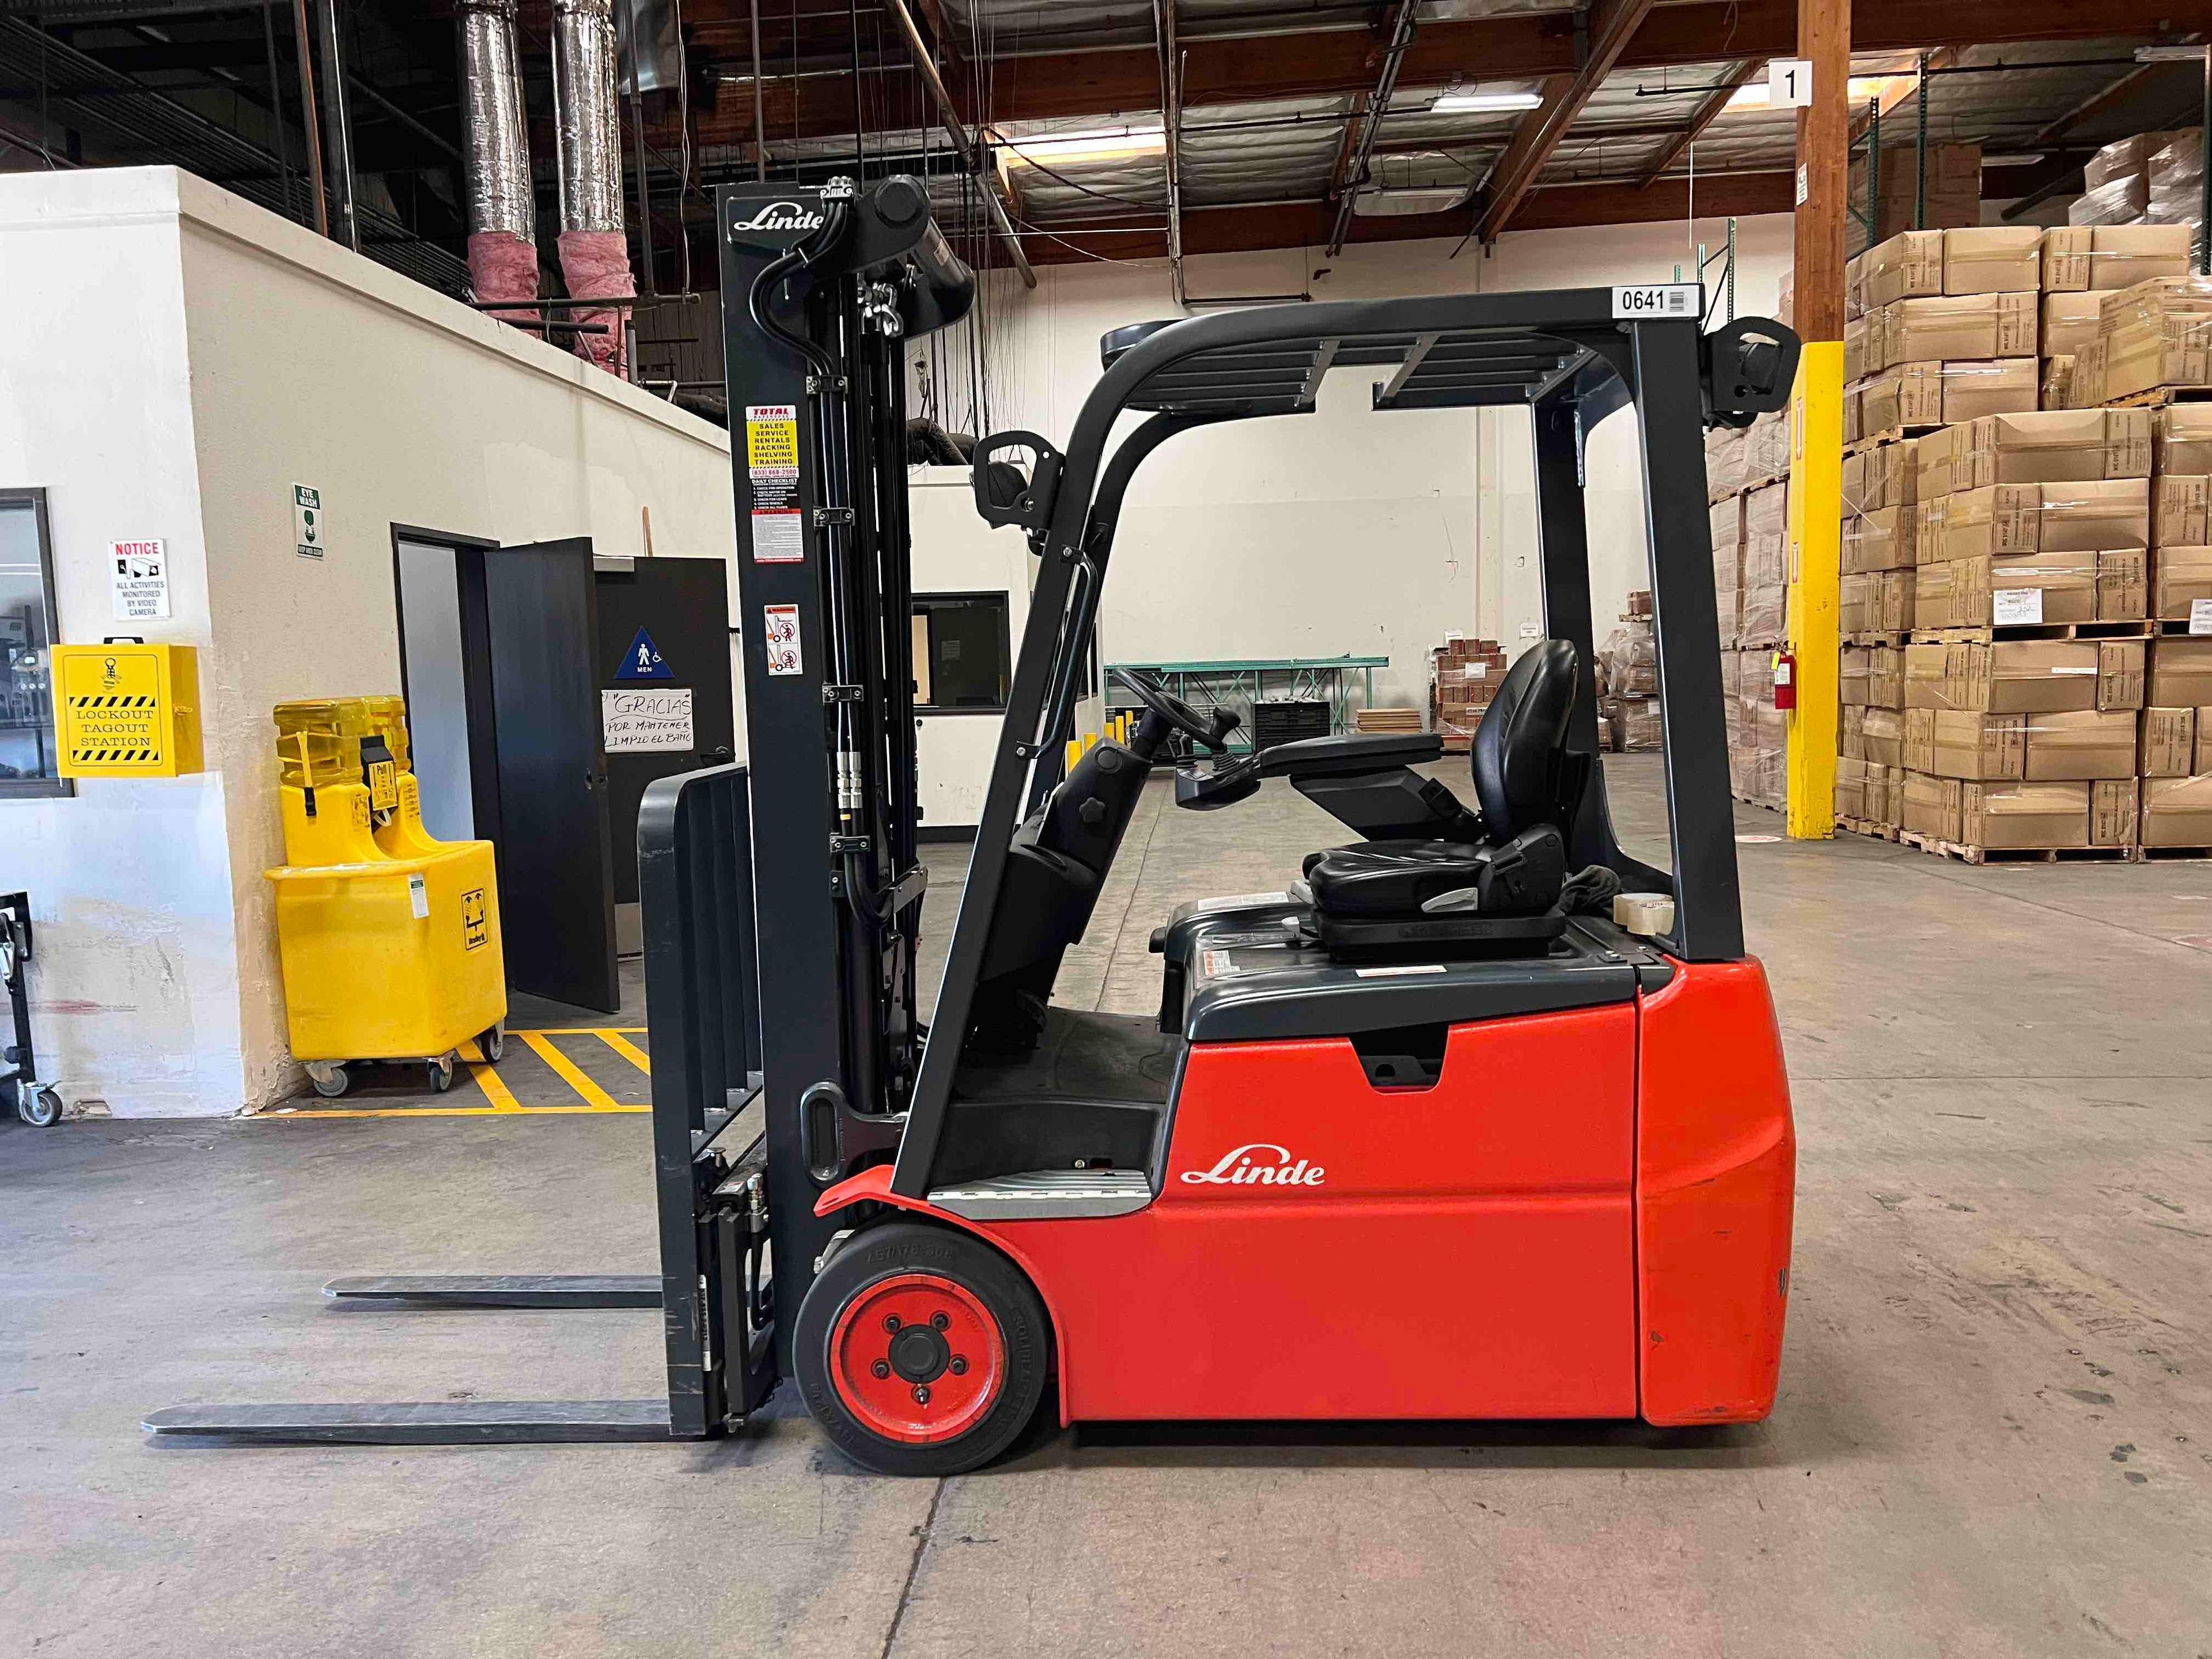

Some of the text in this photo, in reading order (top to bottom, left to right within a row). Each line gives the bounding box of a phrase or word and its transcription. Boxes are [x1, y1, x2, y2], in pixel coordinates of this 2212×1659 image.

[1785, 70, 1795, 99] 1
[733, 202, 824, 230] Linde
[1623, 290, 1663, 310] 0641
[301, 488, 313, 498] EYE
[299, 495, 317, 507] WASH
[115, 543, 160, 555] NOTICE
[75, 711, 153, 719] LOCKOUT
[81, 724, 149, 732] TAGOUT
[605, 721, 691, 733] POR MANTENER
[81, 737, 151, 746] STATION
[605, 735, 649, 747] LIMPIO
[1180, 1143, 1325, 1185] Linde
